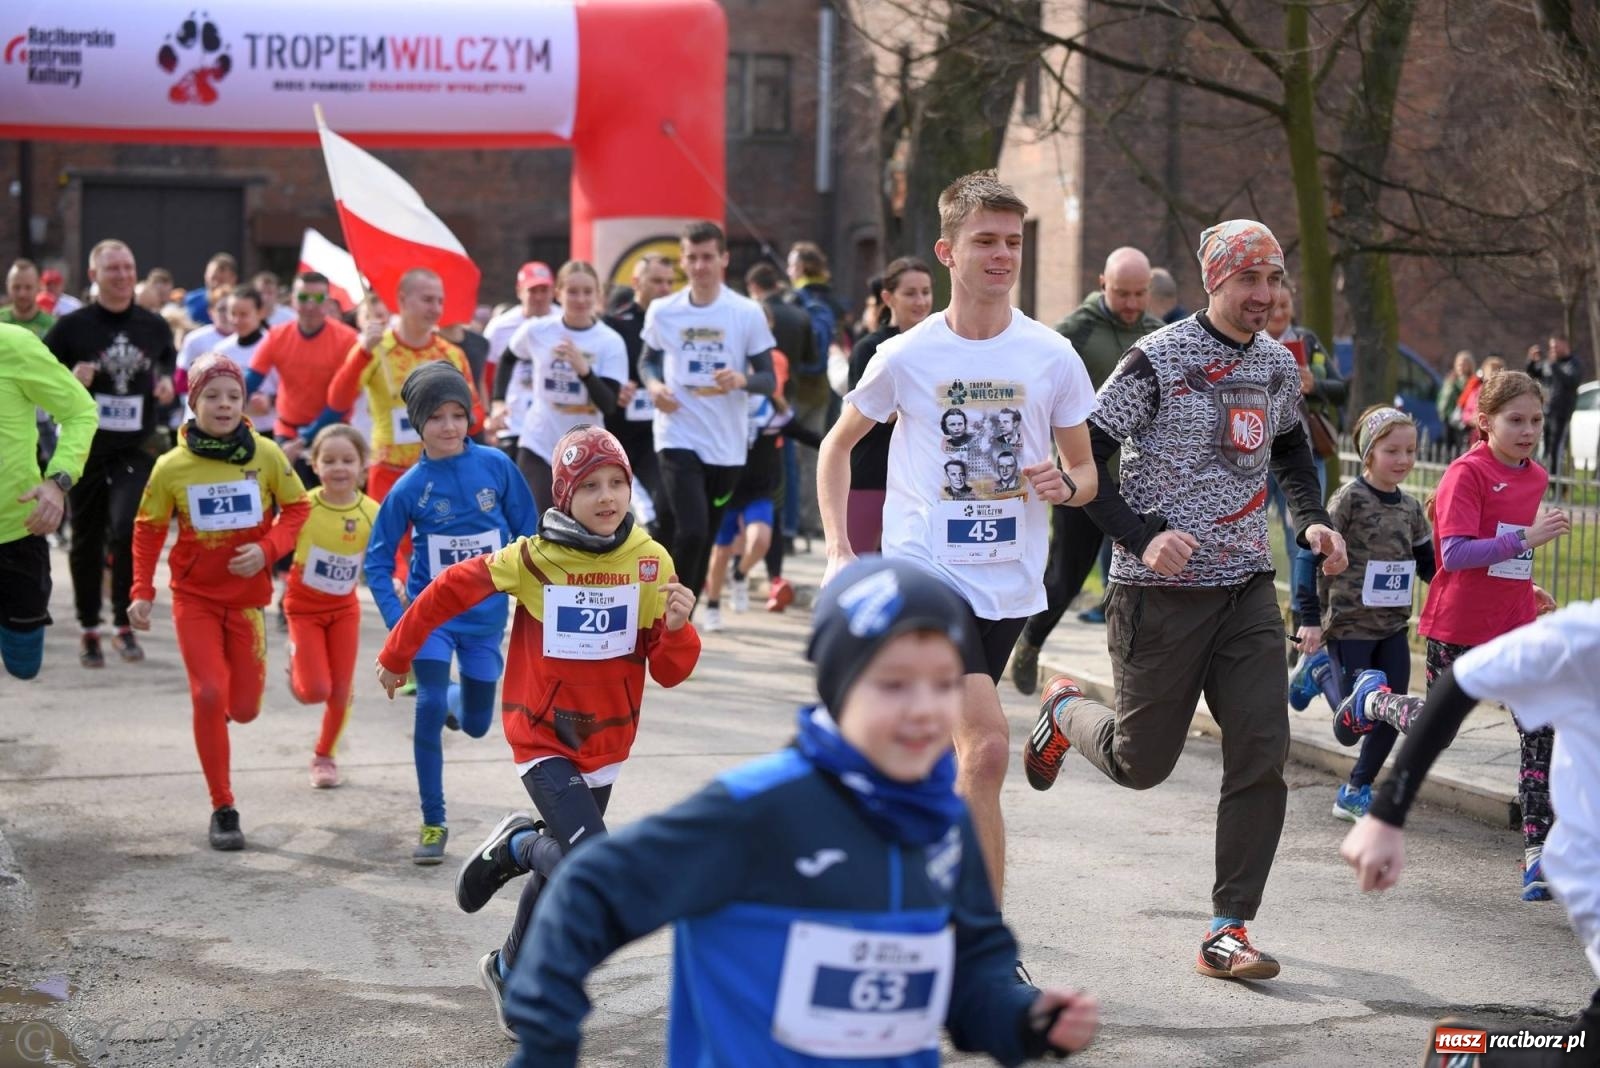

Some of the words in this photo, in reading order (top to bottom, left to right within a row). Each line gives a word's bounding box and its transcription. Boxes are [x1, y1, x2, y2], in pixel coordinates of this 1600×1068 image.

[970, 388, 1014, 400] WILCZYM
[1237, 454, 1255, 467] OCR
[213, 497, 235, 514] 21
[976, 508, 1003, 516] WILCZYM
[968, 520, 998, 542] 45
[325, 564, 353, 580] 100
[566, 572, 630, 585] RACIBORKI
[1385, 575, 1402, 590] 48
[588, 596, 615, 605] WILCZYM
[579, 608, 610, 632] 20
[850, 969, 908, 1012] 63
